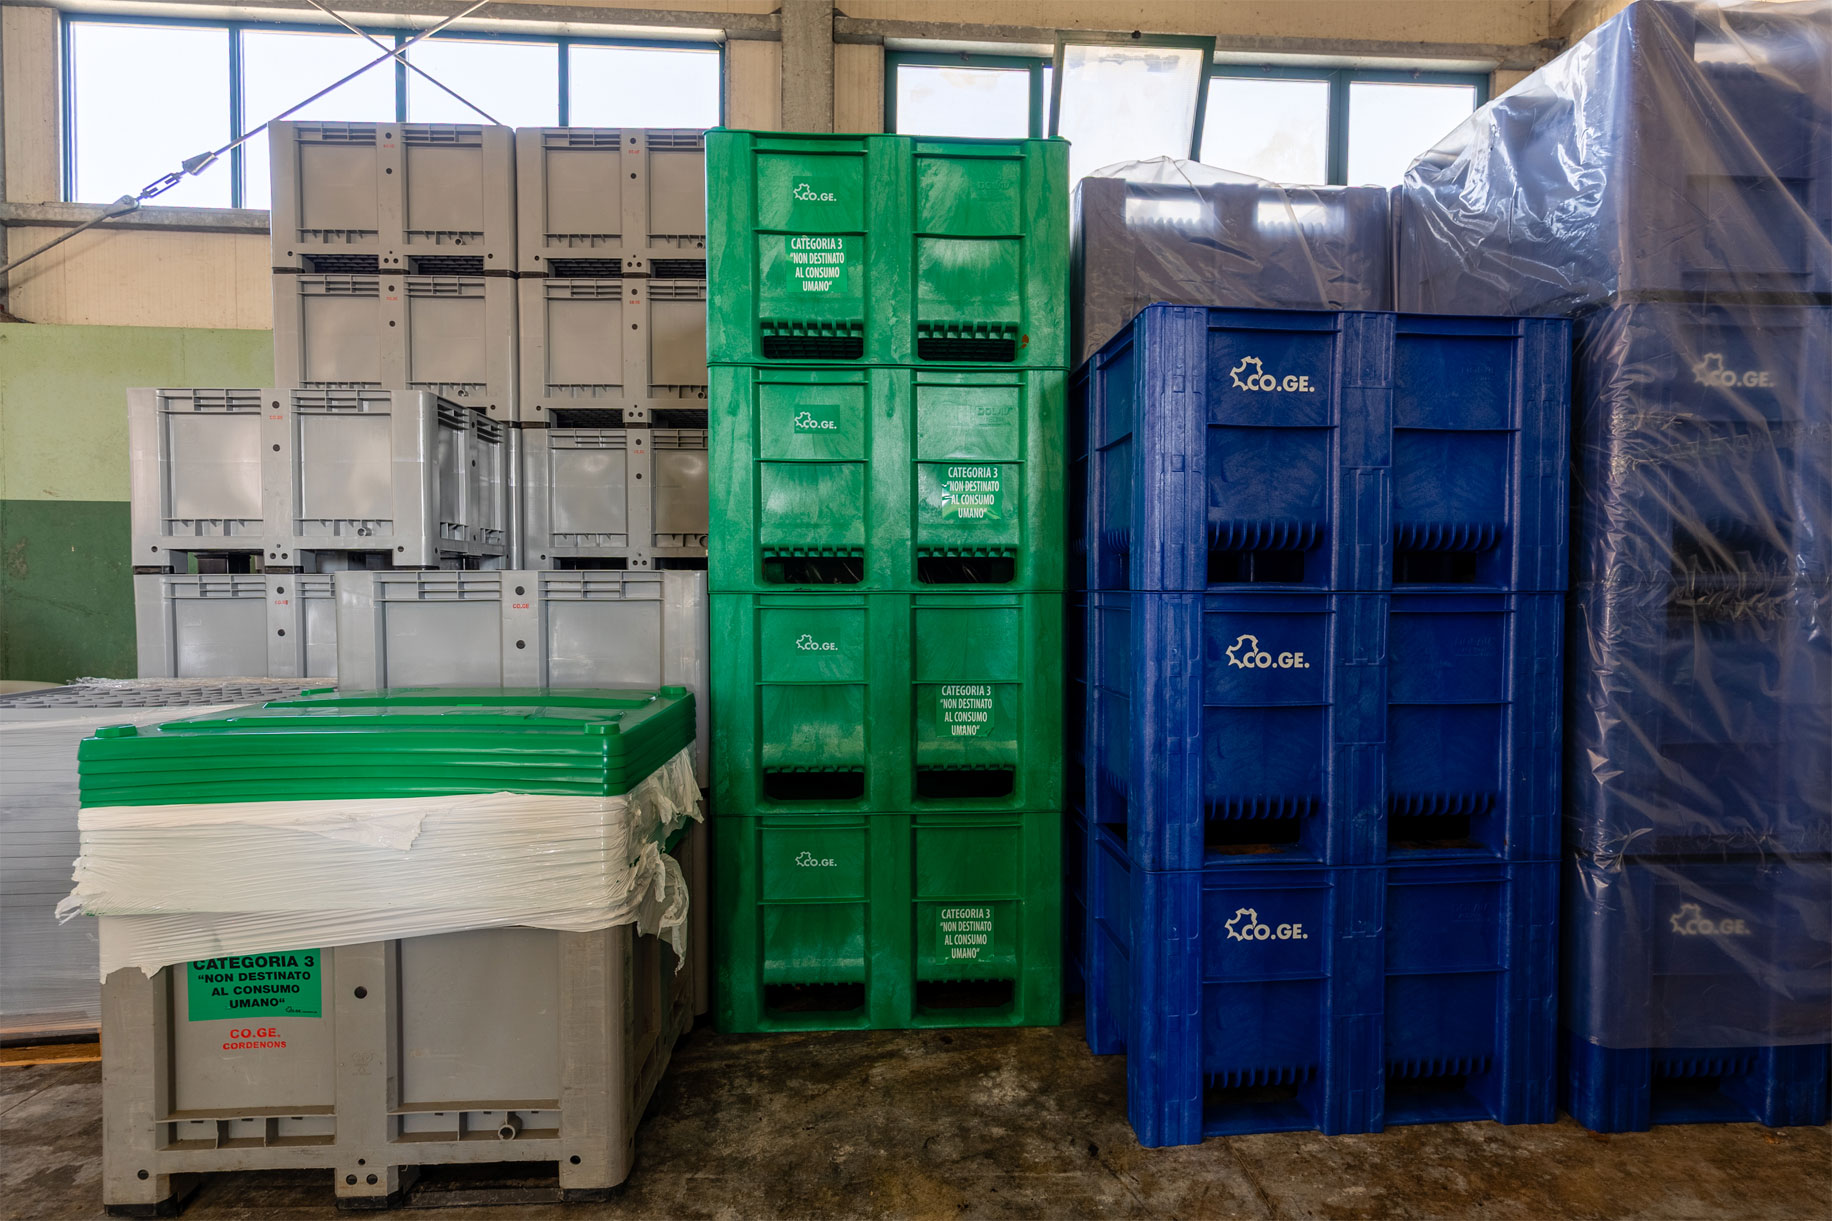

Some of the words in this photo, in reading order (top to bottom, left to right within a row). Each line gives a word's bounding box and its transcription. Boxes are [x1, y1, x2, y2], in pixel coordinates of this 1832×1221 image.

[802, 192, 837, 201] CO.GE.
[791, 238, 836, 250] CATEGORIA
[837, 238, 843, 250] 3
[809, 252, 845, 264] DESTINATO
[795, 267, 804, 278] AL
[805, 266, 840, 278] CONSUMO
[1247, 374, 1315, 392] CO.GE.
[803, 419, 838, 430] CO.GE.
[948, 467, 991, 478] CATEGORIA
[993, 467, 998, 478] 3
[965, 481, 1000, 492] DESTINATO
[951, 495, 960, 505] AL
[961, 494, 995, 505] CONSUMO
[804, 642, 839, 651] CO.GE.
[1243, 651, 1310, 669] CO.GE.
[941, 685, 985, 696] CATEGORIA
[986, 685, 992, 696] 3
[958, 698, 993, 709] DESTINATO
[944, 711, 953, 722] AL
[954, 711, 988, 722] CONSUMO
[803, 858, 838, 867] CO.GE.
[941, 908, 984, 919] CATEGORIA
[985, 908, 991, 919] 3
[958, 921, 992, 932] DESTINATO
[1241, 923, 1309, 941] CO.GE.
[1686, 918, 1751, 935] CO.GE.
[944, 934, 953, 946] AL
[954, 934, 988, 945] CONSUMO
[193, 955, 299, 971] CATEGORIA
[303, 955, 315, 968] 3
[238, 971, 311, 982] DESTINATO
[211, 987, 229, 997] AL
[233, 984, 300, 995] CONSUMO
[229, 1027, 281, 1040] CO.GE.
[222, 1041, 287, 1051] CORDENONS
